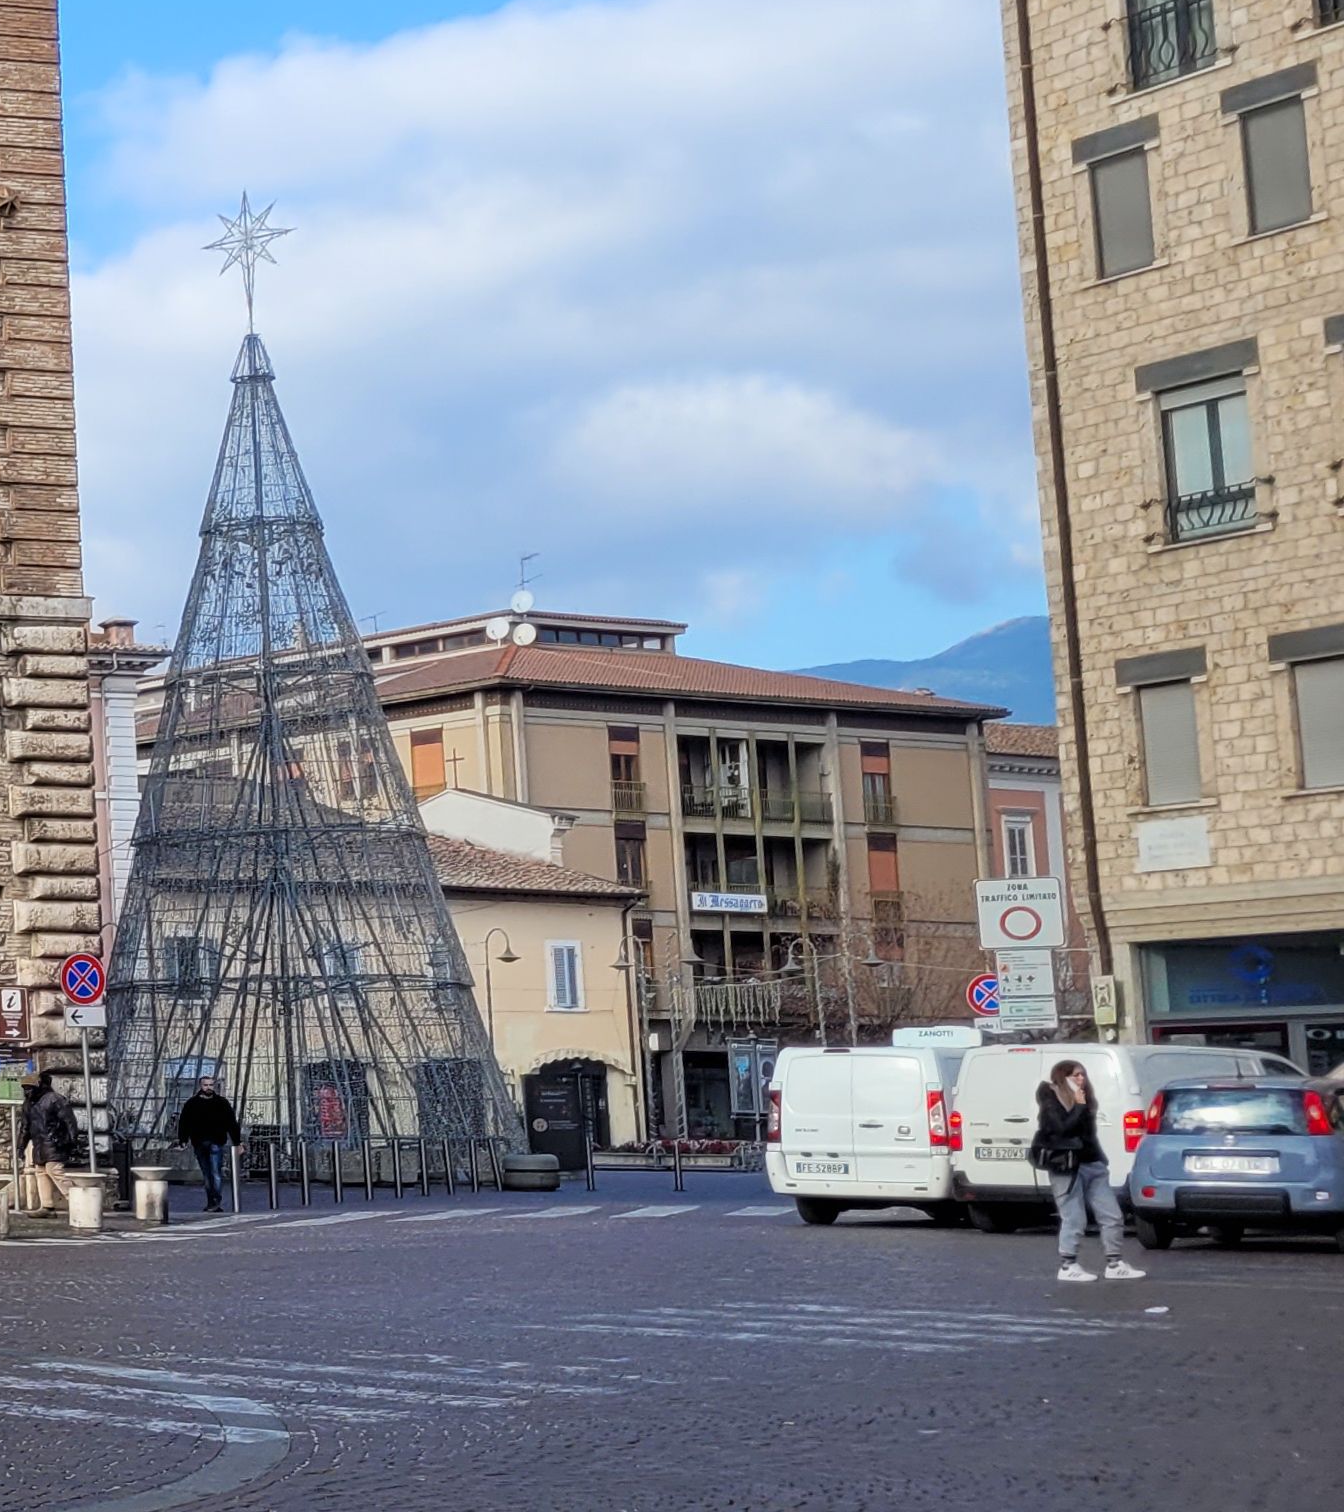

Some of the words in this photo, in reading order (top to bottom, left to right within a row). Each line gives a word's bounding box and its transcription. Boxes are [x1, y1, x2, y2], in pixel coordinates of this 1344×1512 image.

[1007, 883, 1028, 891] ZONA
[980, 894, 1018, 902] TRAFFICO
[1022, 893, 1057, 901] LIMITATO
